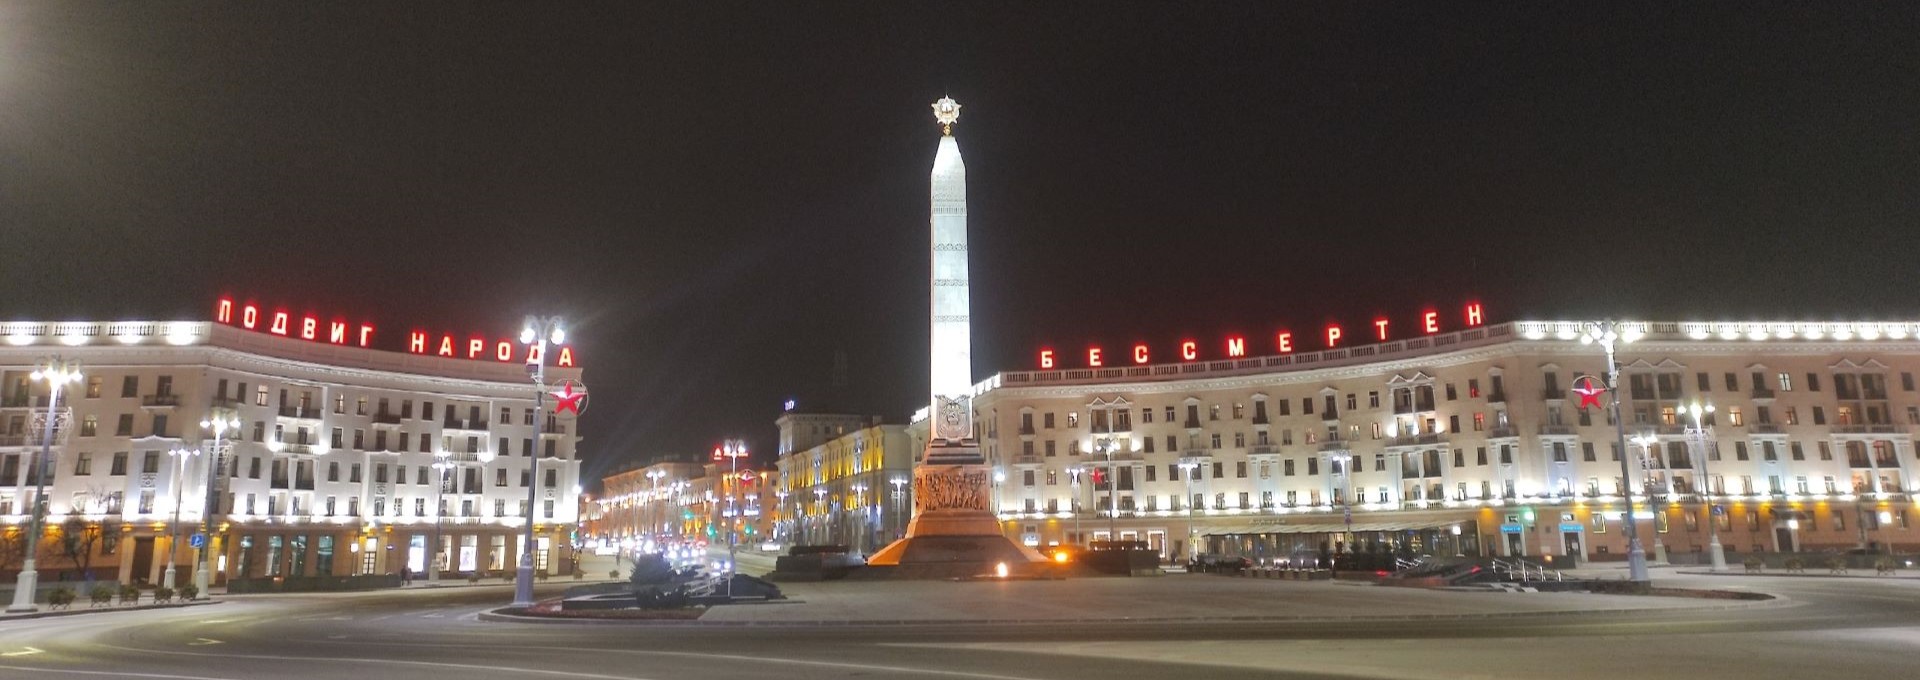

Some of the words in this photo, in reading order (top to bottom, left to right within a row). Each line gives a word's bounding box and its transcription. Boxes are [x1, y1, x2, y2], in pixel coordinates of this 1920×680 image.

[218, 299, 374, 347] ПОДВИГ
[411, 331, 573, 368] НАРОДА
[1041, 303, 1483, 369] БЕССМЕРТЕН
